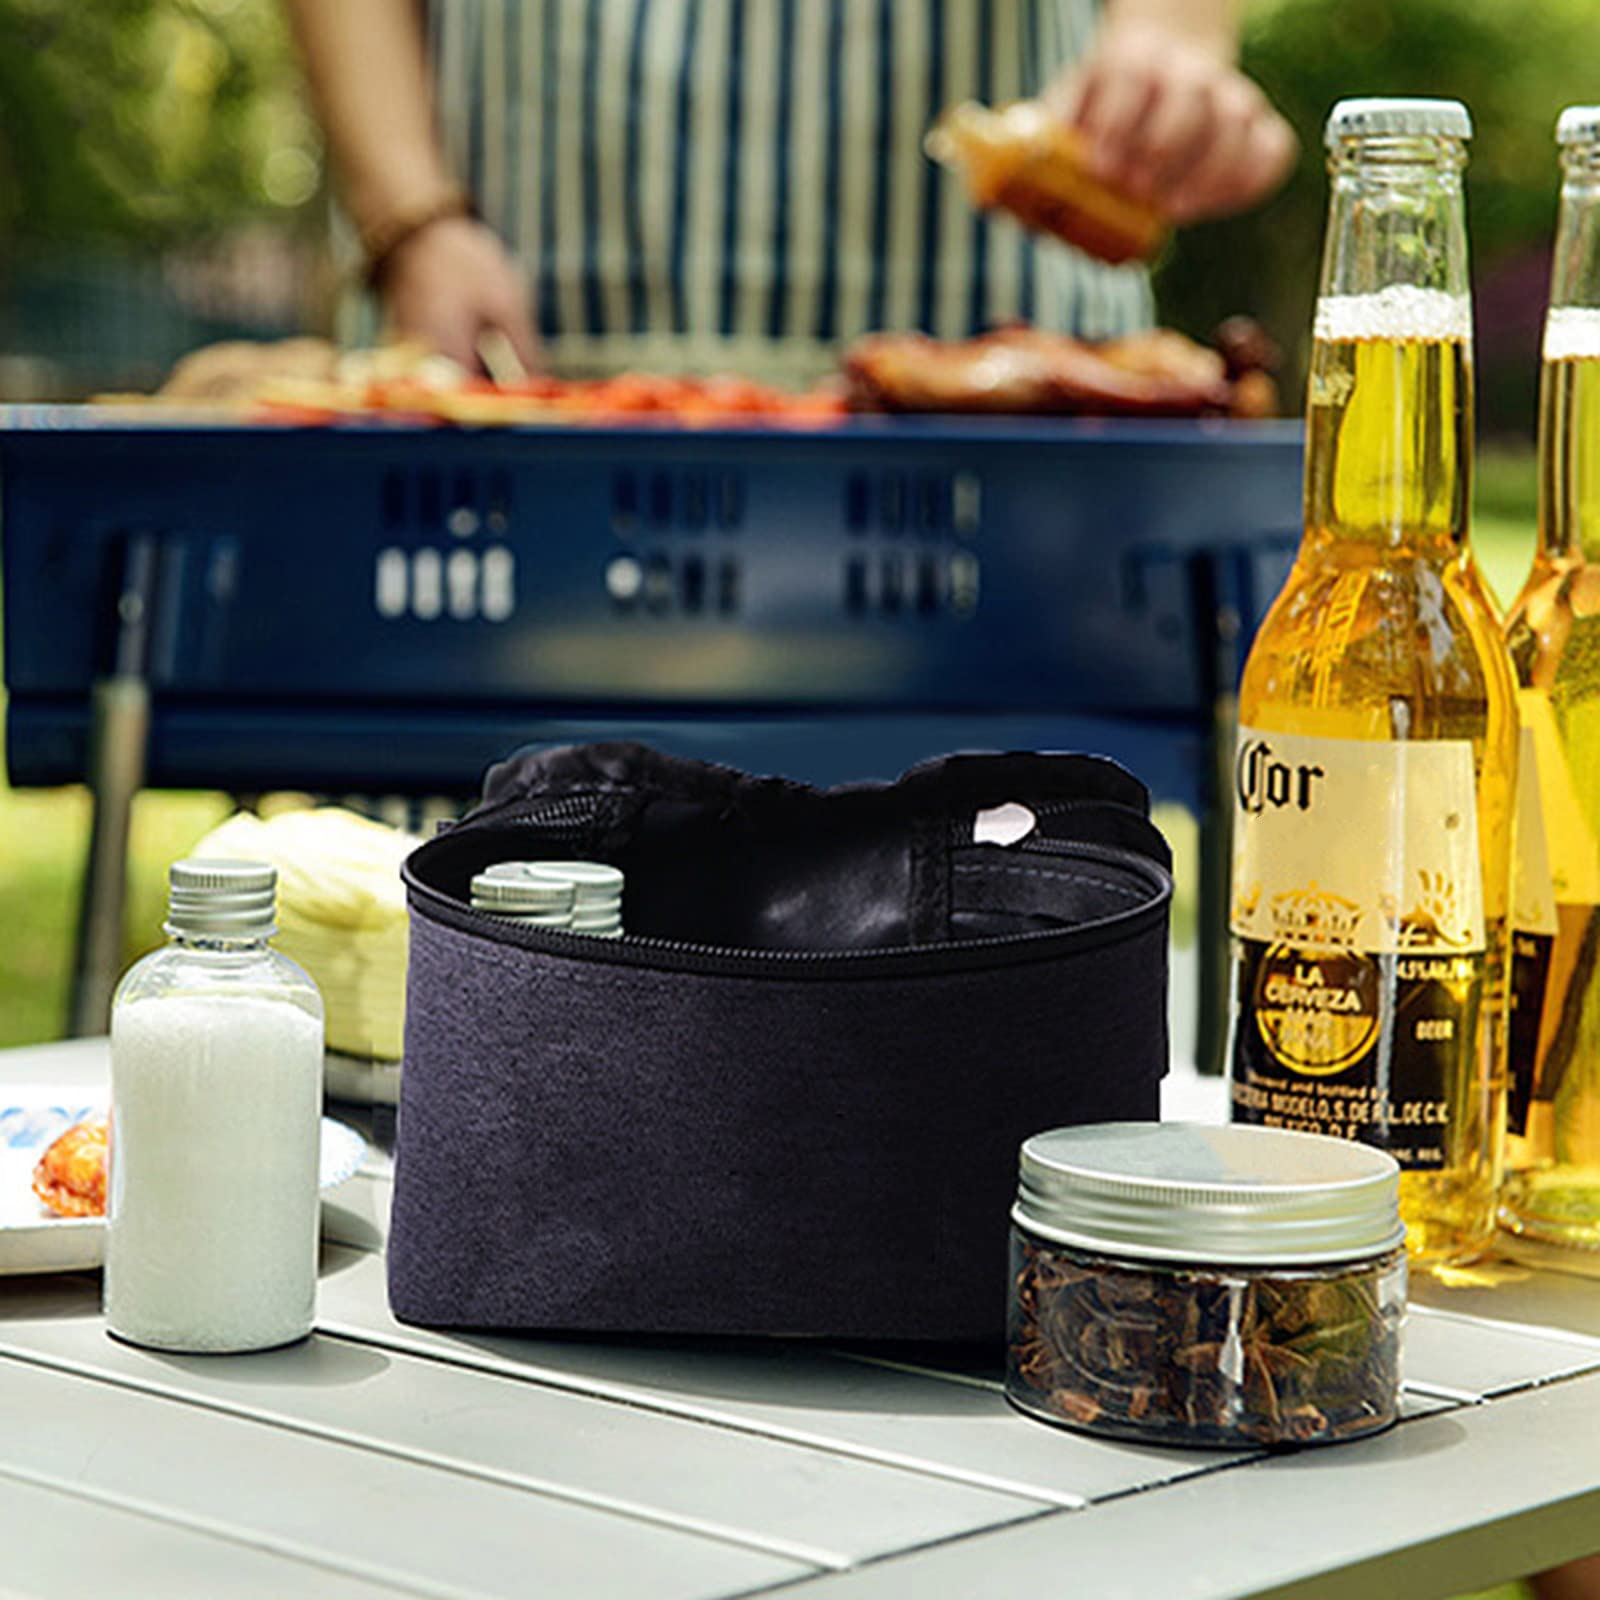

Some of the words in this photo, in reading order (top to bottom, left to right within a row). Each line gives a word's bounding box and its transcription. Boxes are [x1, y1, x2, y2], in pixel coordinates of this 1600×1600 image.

[1237, 741, 1324, 813] Cor
[1295, 963, 1324, 987] LA
[1265, 981, 1361, 1012] CERVEZA
